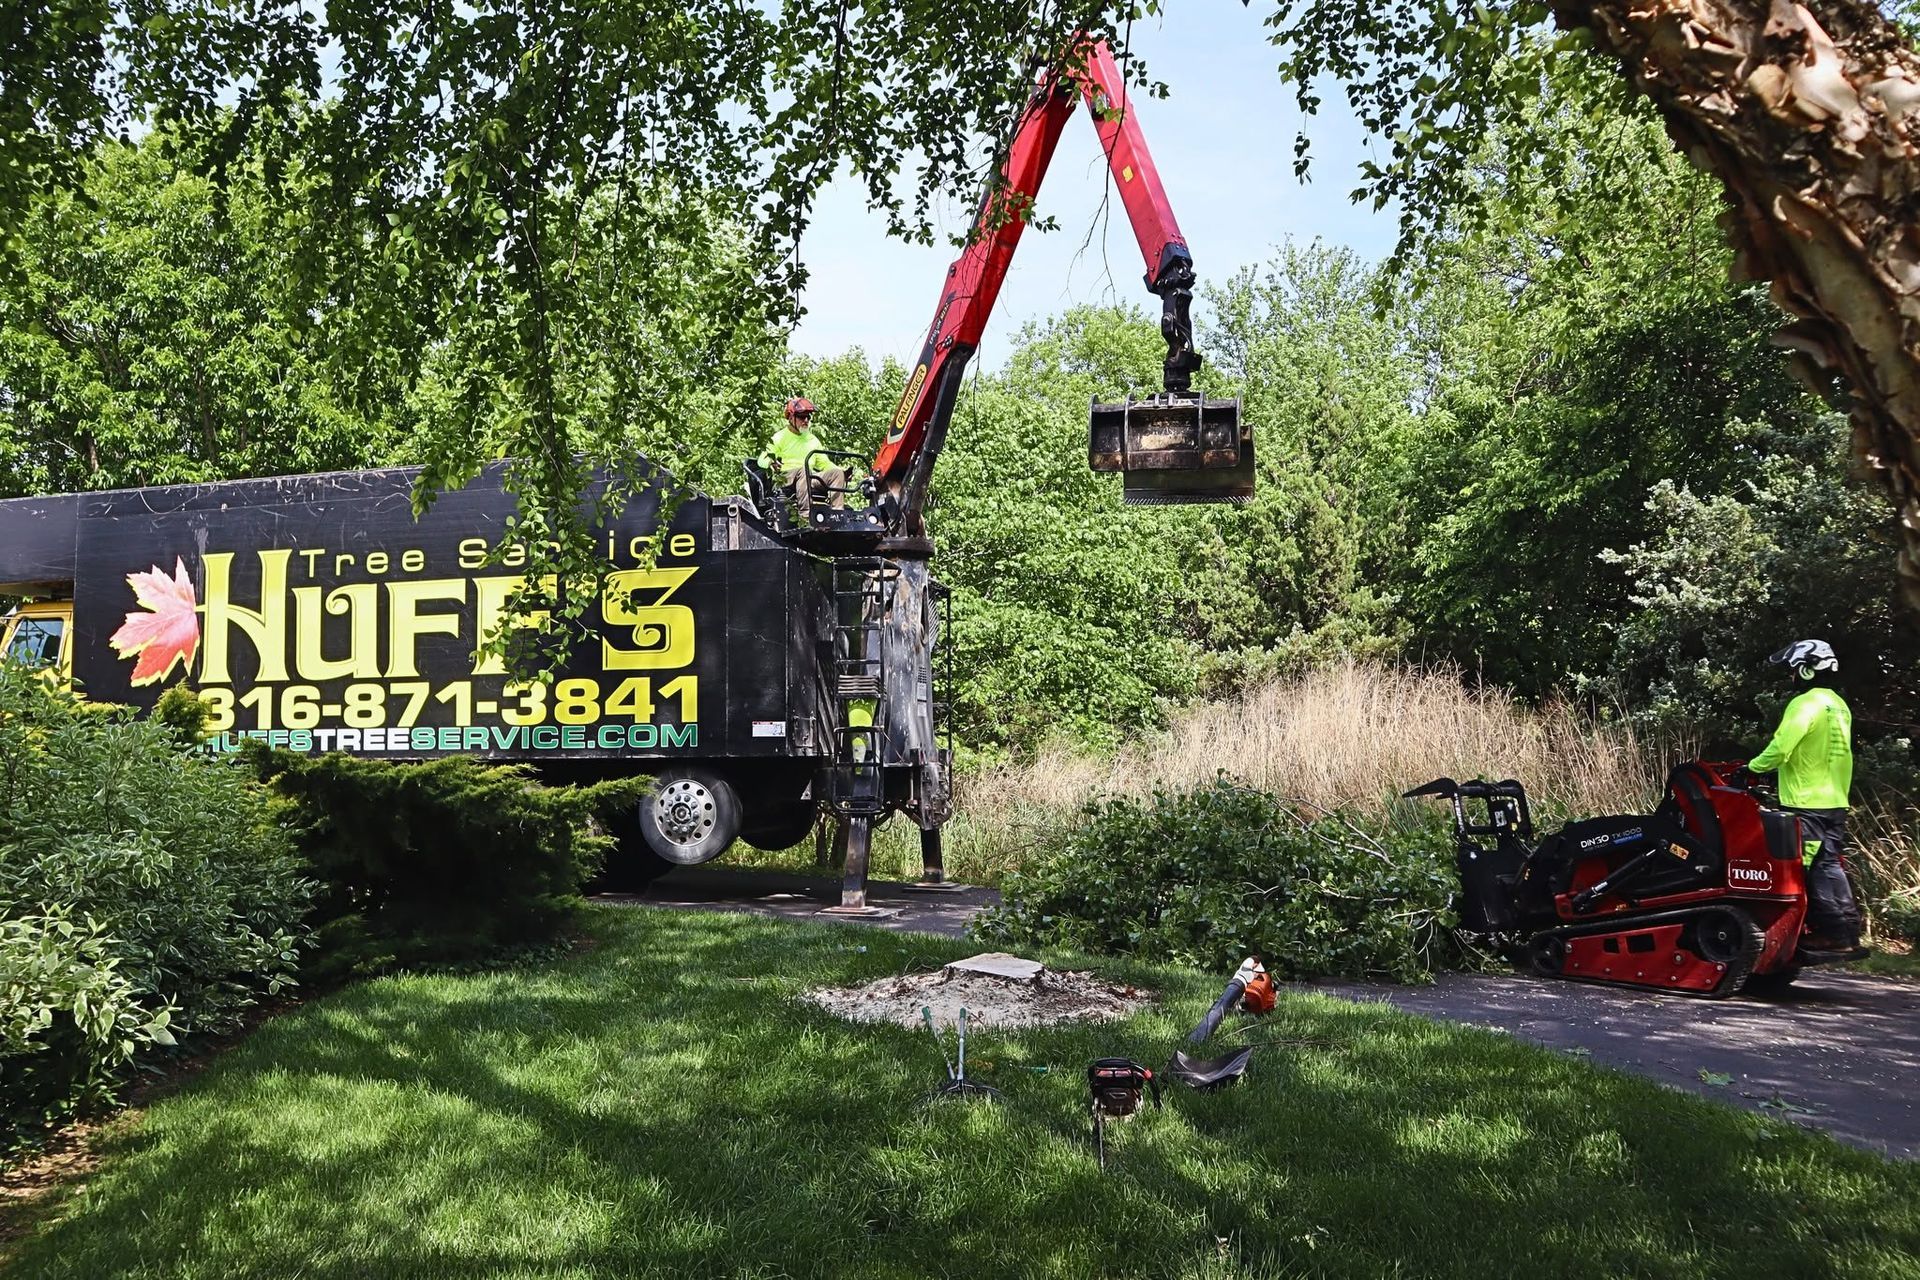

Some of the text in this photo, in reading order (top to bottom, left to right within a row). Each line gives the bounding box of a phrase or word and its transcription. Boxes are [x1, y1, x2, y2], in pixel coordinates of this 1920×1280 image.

[897, 367, 925, 425] PALFINGER
[299, 529, 696, 578] Tree Seice
[198, 675, 698, 731] 316-871-3841
[1580, 834, 1610, 849] DINGO
[1732, 868, 1768, 881] TORO
